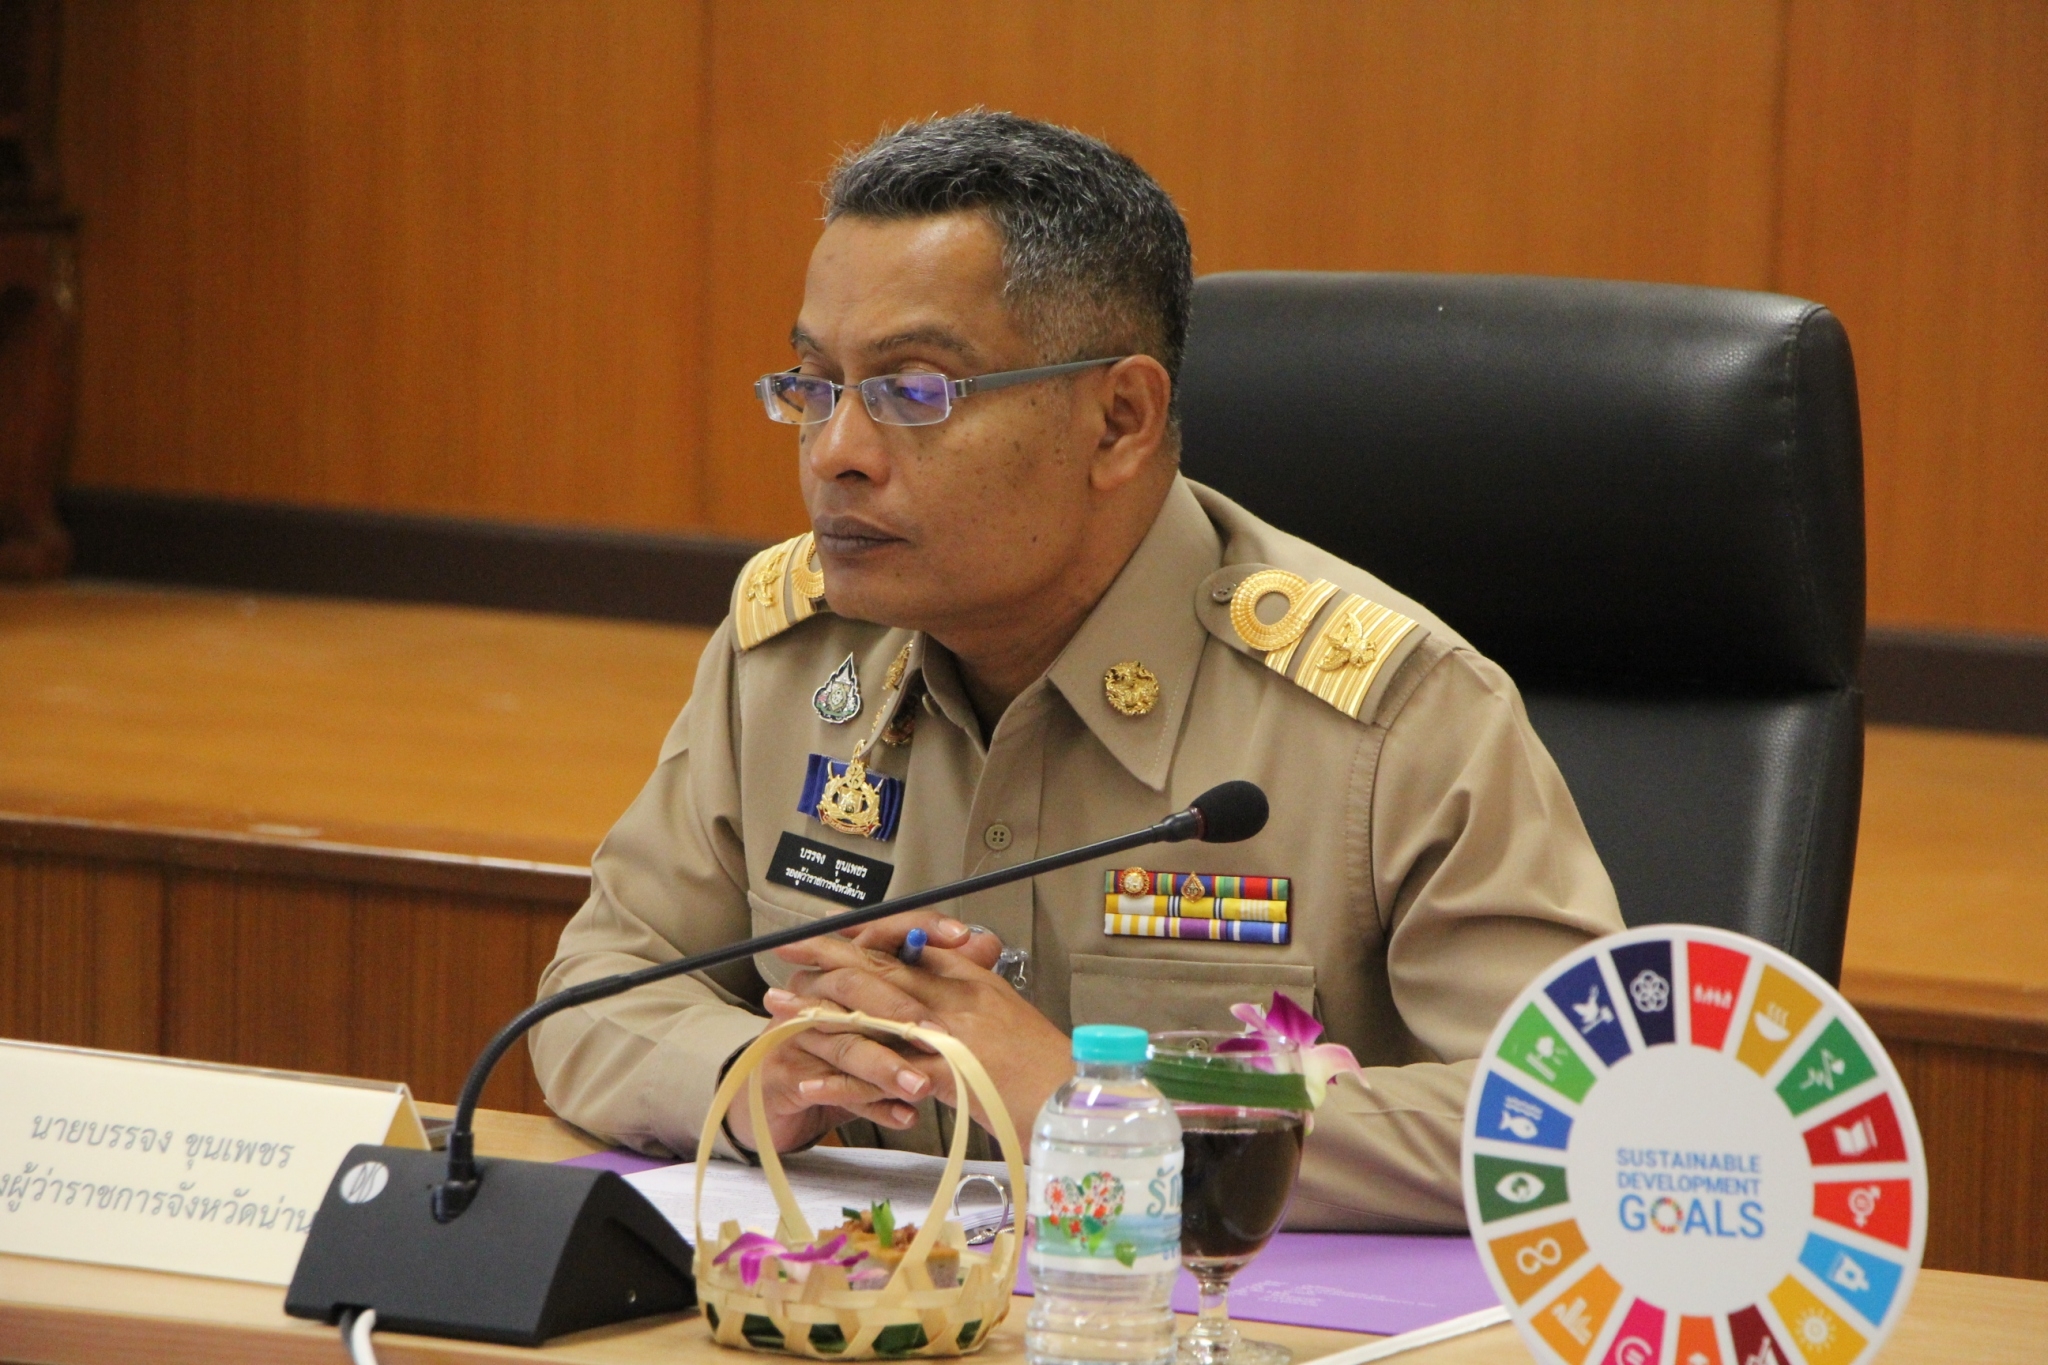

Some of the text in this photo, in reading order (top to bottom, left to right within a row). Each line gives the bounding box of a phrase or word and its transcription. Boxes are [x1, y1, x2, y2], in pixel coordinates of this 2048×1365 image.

[800, 847, 826, 865] บรรจง
[31, 1114, 296, 1170] นายบรรจง ขุนเพชร
[1616, 1148, 1761, 1173] SUSTAINABLE
[1617, 1170, 1761, 1195] DEVELOPMENT
[1618, 1193, 1765, 1239] GOALS
